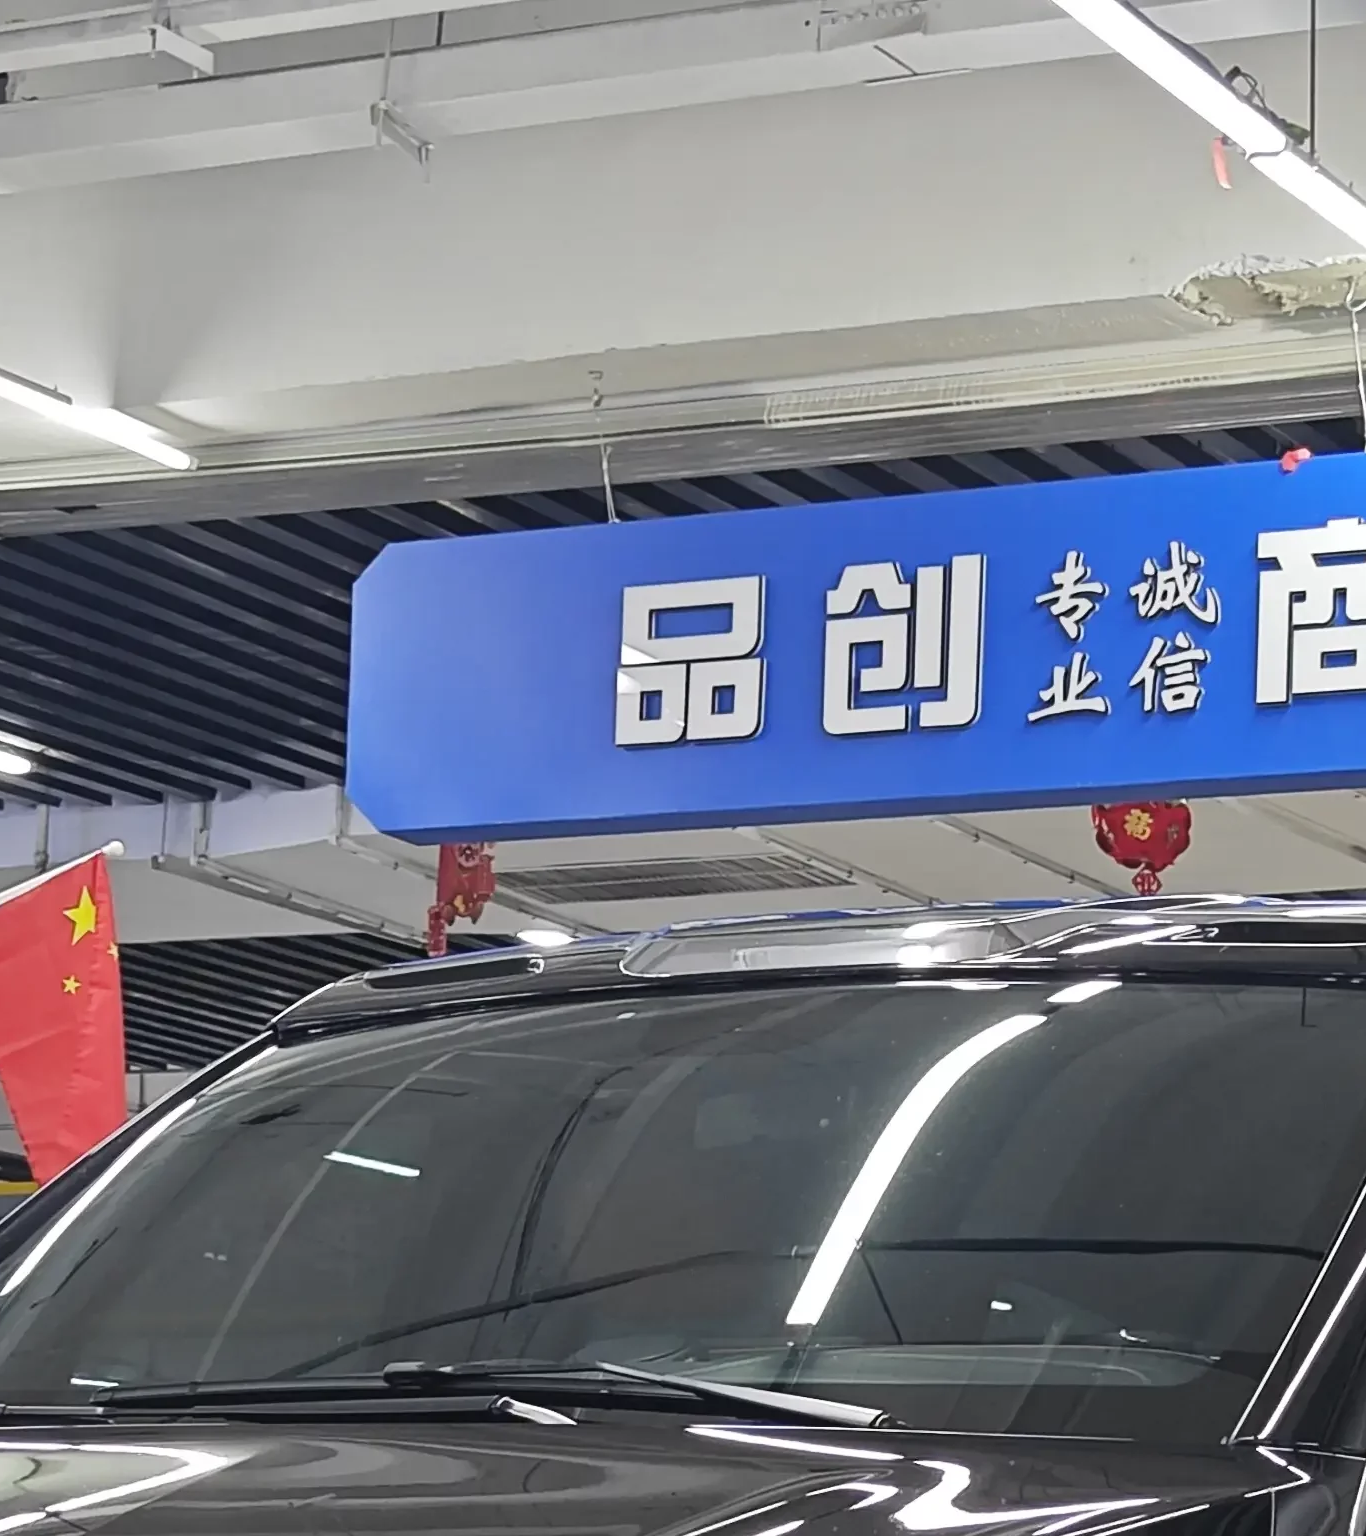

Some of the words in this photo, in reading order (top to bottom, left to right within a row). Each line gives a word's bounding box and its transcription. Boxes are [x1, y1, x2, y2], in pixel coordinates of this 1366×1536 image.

[615, 553, 986, 749] 品创
[1027, 550, 1111, 724] 专业
[1129, 541, 1221, 714] 诚信
